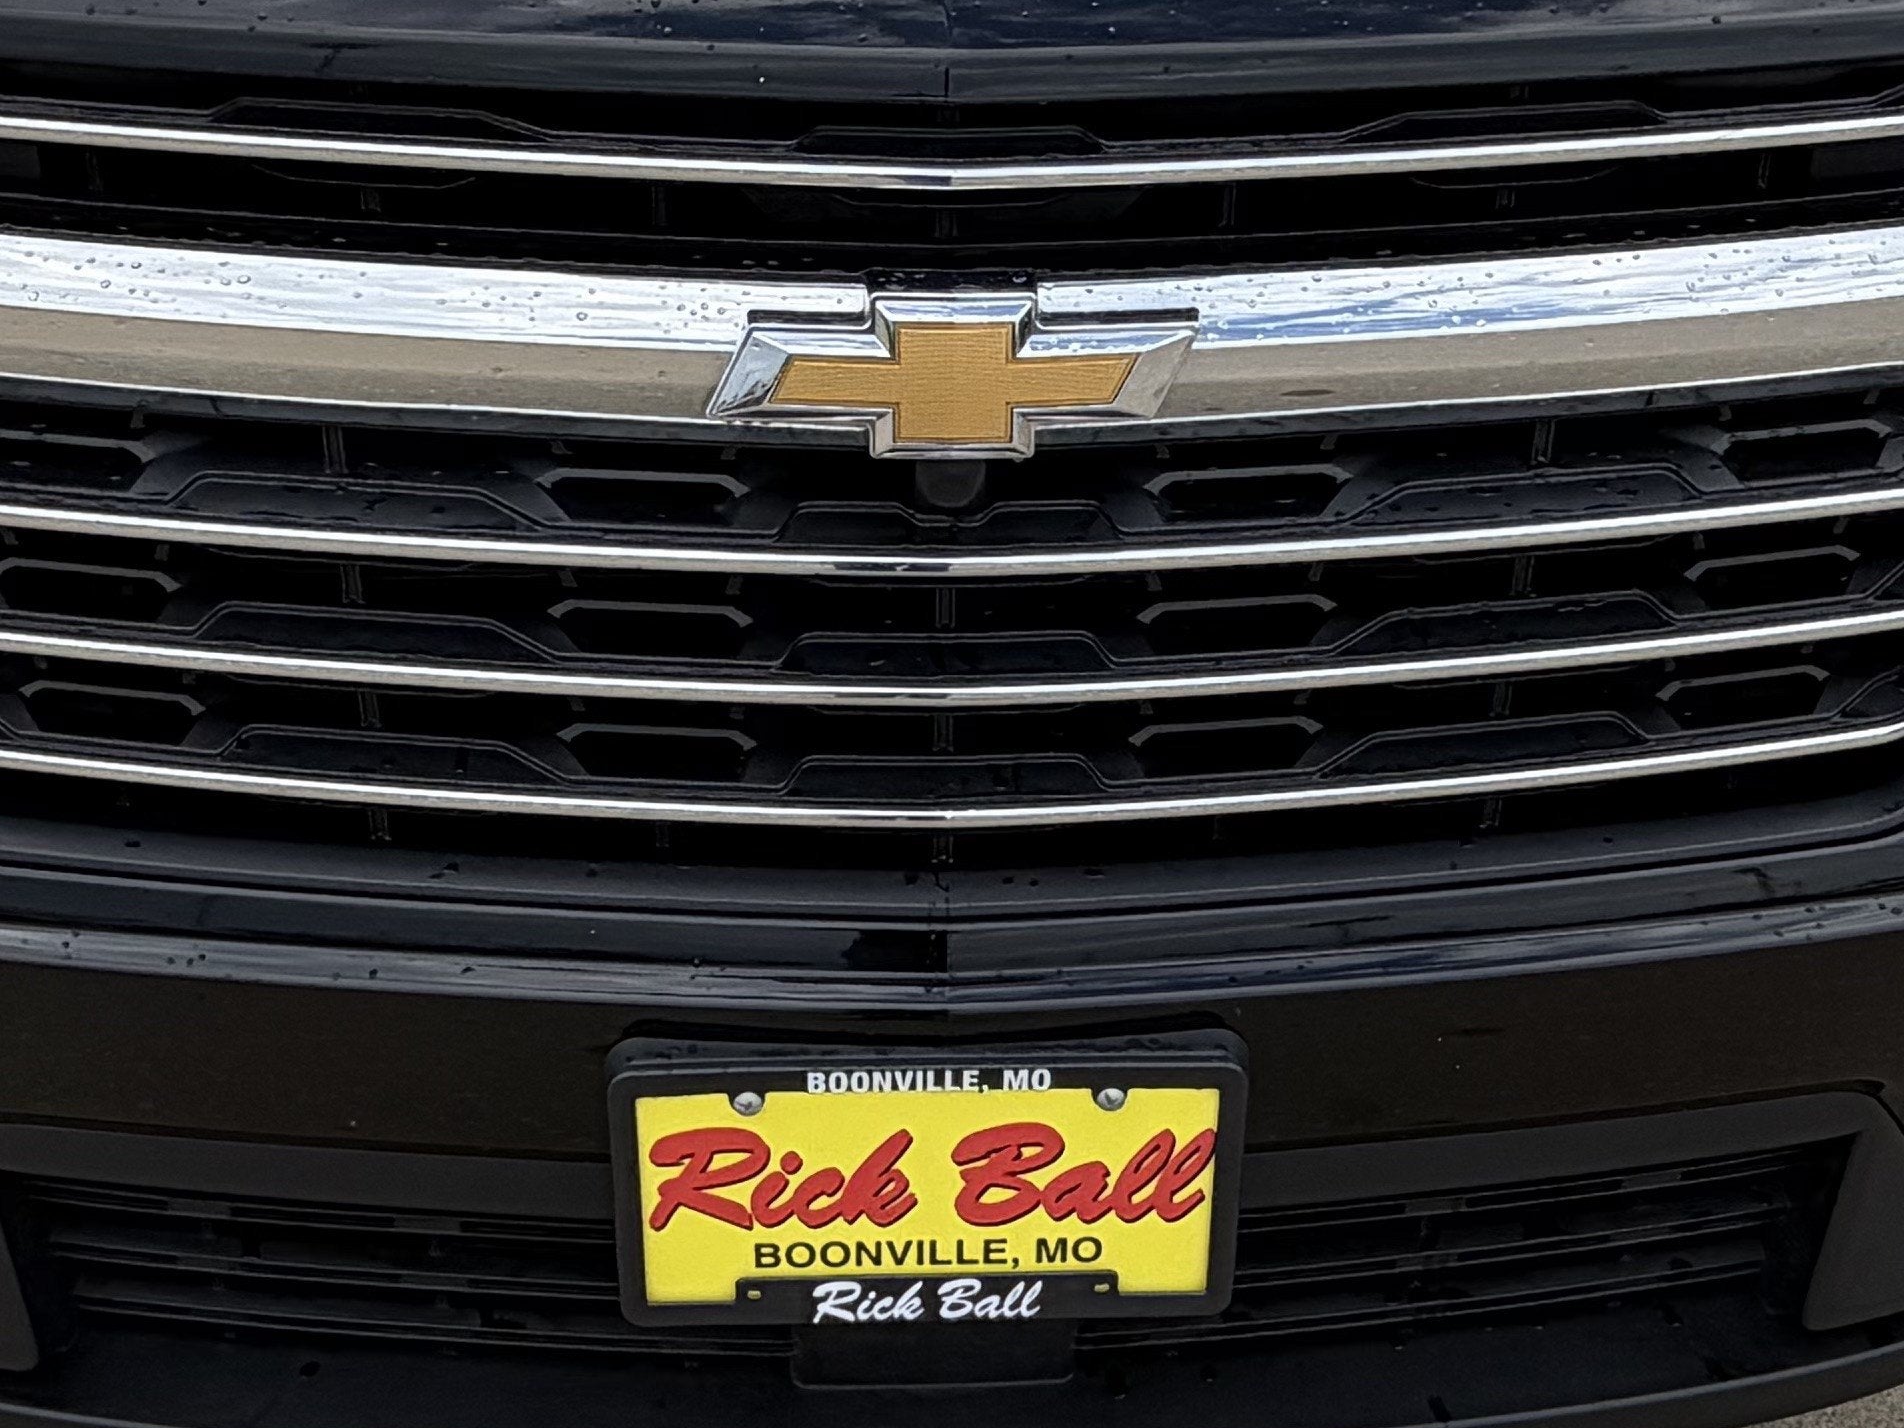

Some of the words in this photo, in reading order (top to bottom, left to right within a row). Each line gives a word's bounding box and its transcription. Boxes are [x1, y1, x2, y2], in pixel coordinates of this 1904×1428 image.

[806, 1071, 990, 1095] BOONVILLE,
[1001, 1069, 1052, 1092] MO
[648, 1125, 919, 1232] Rick
[951, 1122, 1216, 1227] Ball
[754, 1238, 1019, 1269] BOONVILLE,
[1035, 1236, 1103, 1264] MO
[812, 1280, 923, 1324] Rick
[936, 1279, 1042, 1320] Ball
